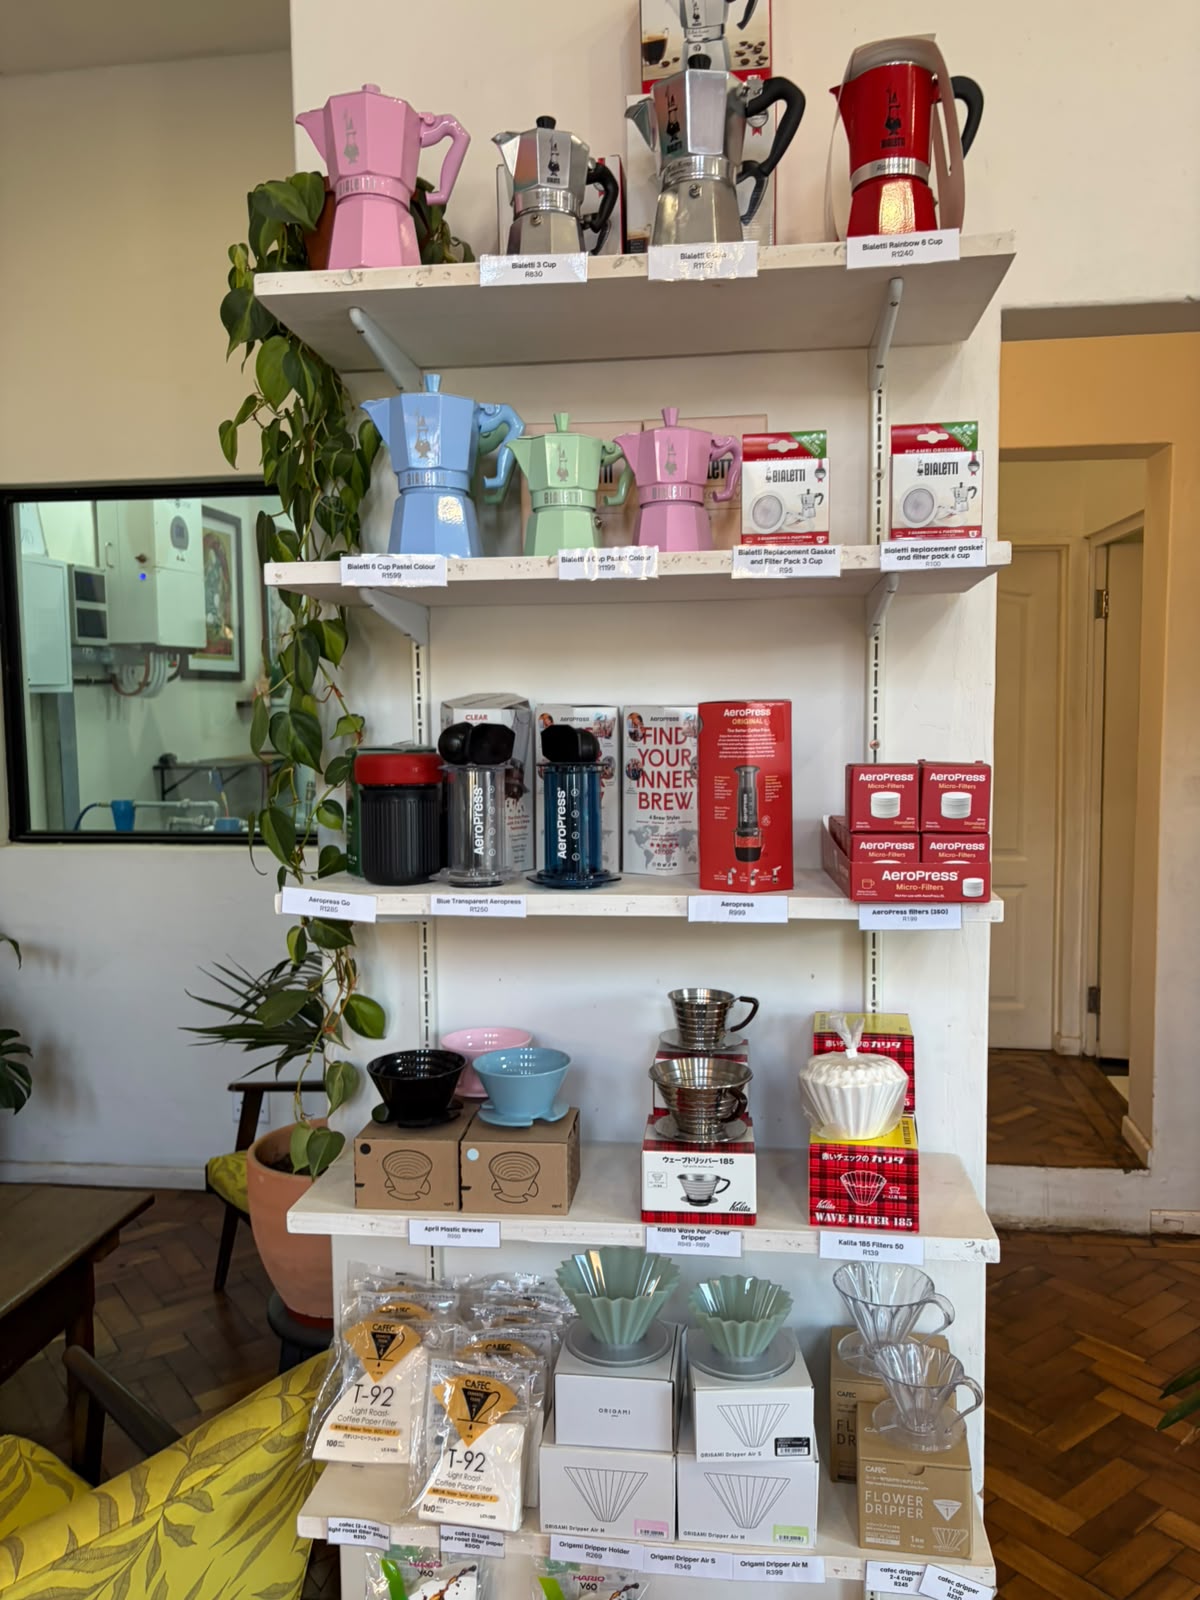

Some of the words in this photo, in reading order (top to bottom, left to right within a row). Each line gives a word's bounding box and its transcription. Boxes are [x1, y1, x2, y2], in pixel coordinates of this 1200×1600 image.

[862, 243, 888, 251] Bialetti
[889, 240, 920, 249] Rainbow
[928, 238, 943, 246] Cup
[680, 252, 705, 260] Bialetti
[892, 250, 914, 258] R1240
[542, 261, 557, 269] Cup
[764, 548, 809, 556] Replacement
[910, 546, 957, 554] Replacement
[958, 545, 983, 553] gasket
[724, 708, 771, 717] AeroPress
[642, 727, 688, 745] FIND
[638, 748, 692, 767] YOUR
[859, 774, 914, 782] AeroPress
[930, 773, 986, 782] AeroPress
[638, 792, 693, 811] BREW
[474, 786, 485, 856] AeroPress
[557, 788, 567, 860] AeroPress
[860, 842, 915, 850] AeroPress
[930, 842, 985, 850] AeroPress
[882, 870, 958, 881] AeroPress
[308, 896, 340, 905] Aeropress
[452, 898, 488, 906] Transparent
[490, 898, 522, 906] Aeropress
[729, 1202, 751, 1212] Kalita
[815, 1212, 845, 1223] WAVE
[848, 1214, 890, 1226] FILTER
[894, 1217, 913, 1227] 185
[372, 1324, 396, 1332] CAFEC
[465, 1380, 491, 1390] CAFEC
[354, 1384, 394, 1407] T-92
[338, 1414, 360, 1424] Coffee
[362, 1418, 381, 1426] Paper
[382, 1418, 398, 1426] Filter
[327, 1440, 338, 1448] 100
[449, 1448, 486, 1473] T-92
[435, 1479, 456, 1488] Coffee
[457, 1482, 476, 1491] Paper
[866, 1490, 924, 1507] FLOWER
[423, 1504, 436, 1513] 100
[866, 1502, 924, 1519] DRIPPER
[373, 1532, 389, 1540] paper
[584, 1544, 607, 1552] Dripper
[608, 1547, 630, 1555] Holder
[740, 1560, 765, 1568] Origami
[572, 1575, 605, 1583] HARIO
[580, 1582, 598, 1591] V60
[938, 1576, 955, 1586] cafec
[956, 1582, 980, 1595] dripper
[952, 1588, 965, 1596] cup
